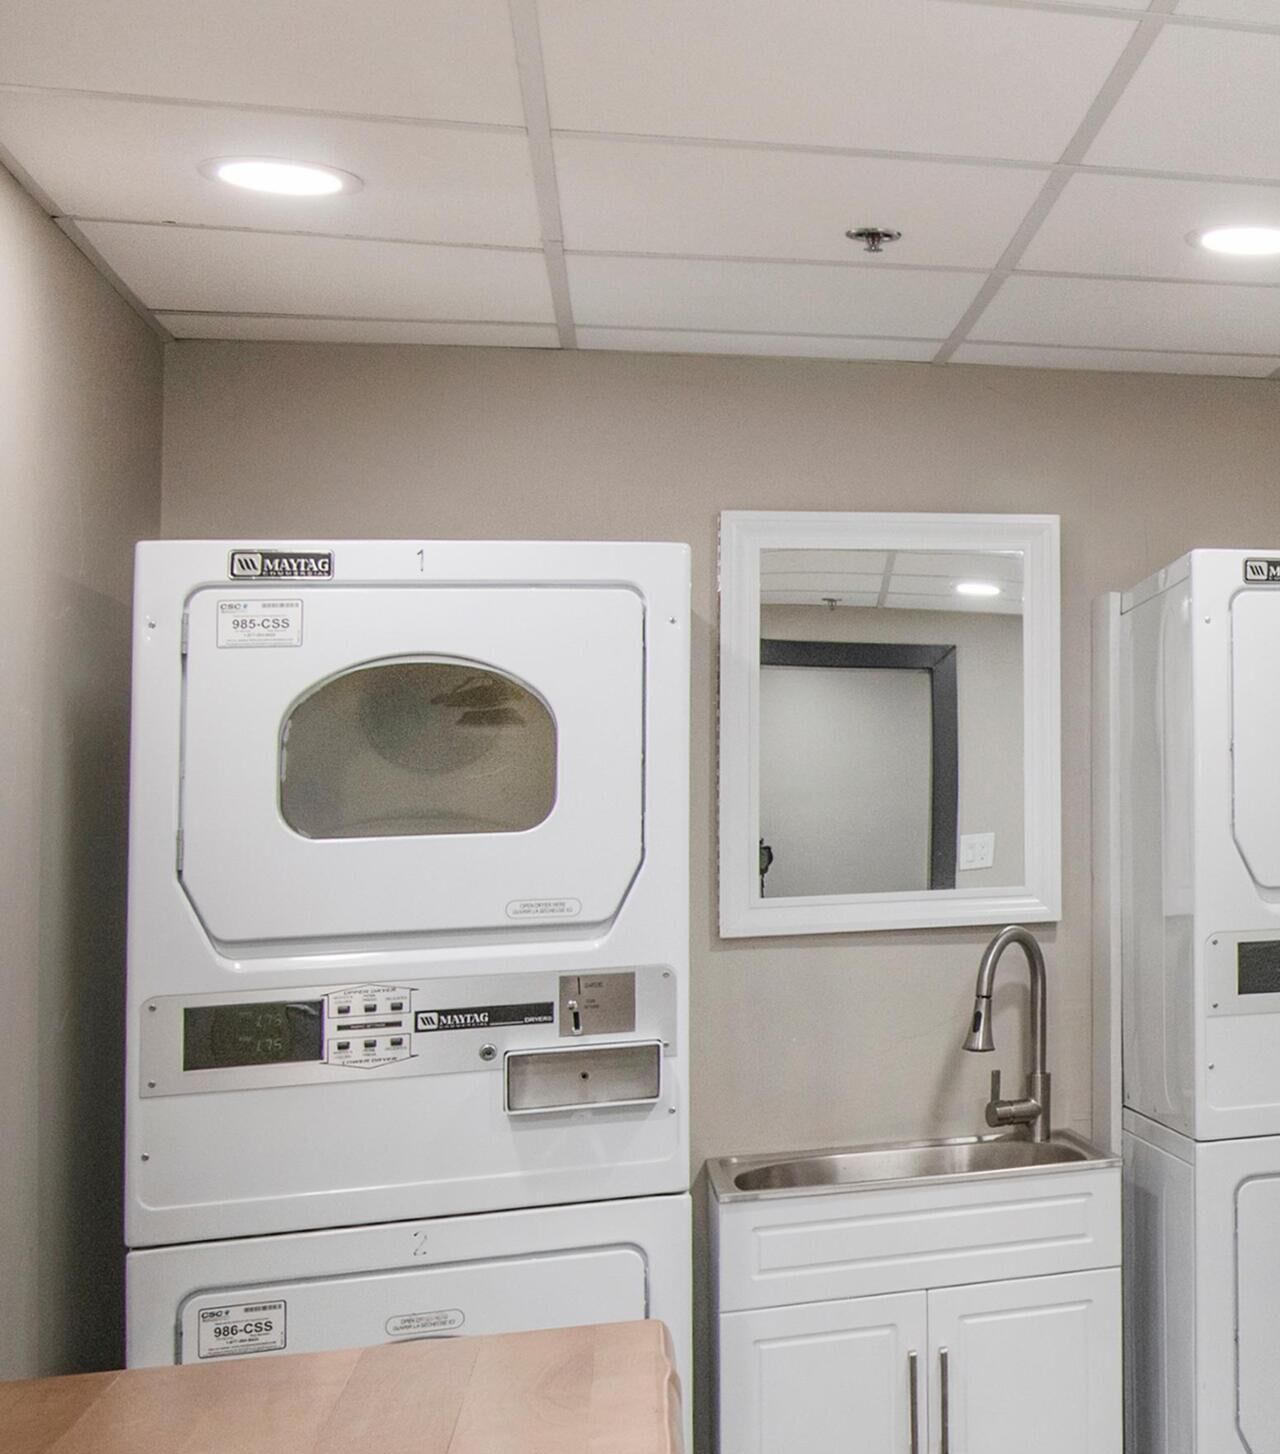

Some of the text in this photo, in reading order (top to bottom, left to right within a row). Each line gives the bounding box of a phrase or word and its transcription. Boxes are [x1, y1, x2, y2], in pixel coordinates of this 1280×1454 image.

[263, 559, 329, 571] MAYTAG
[232, 618, 290, 630] 985-CSS
[440, 1012, 489, 1025] MAYTAG
[214, 1320, 273, 1338] 986-CSS
